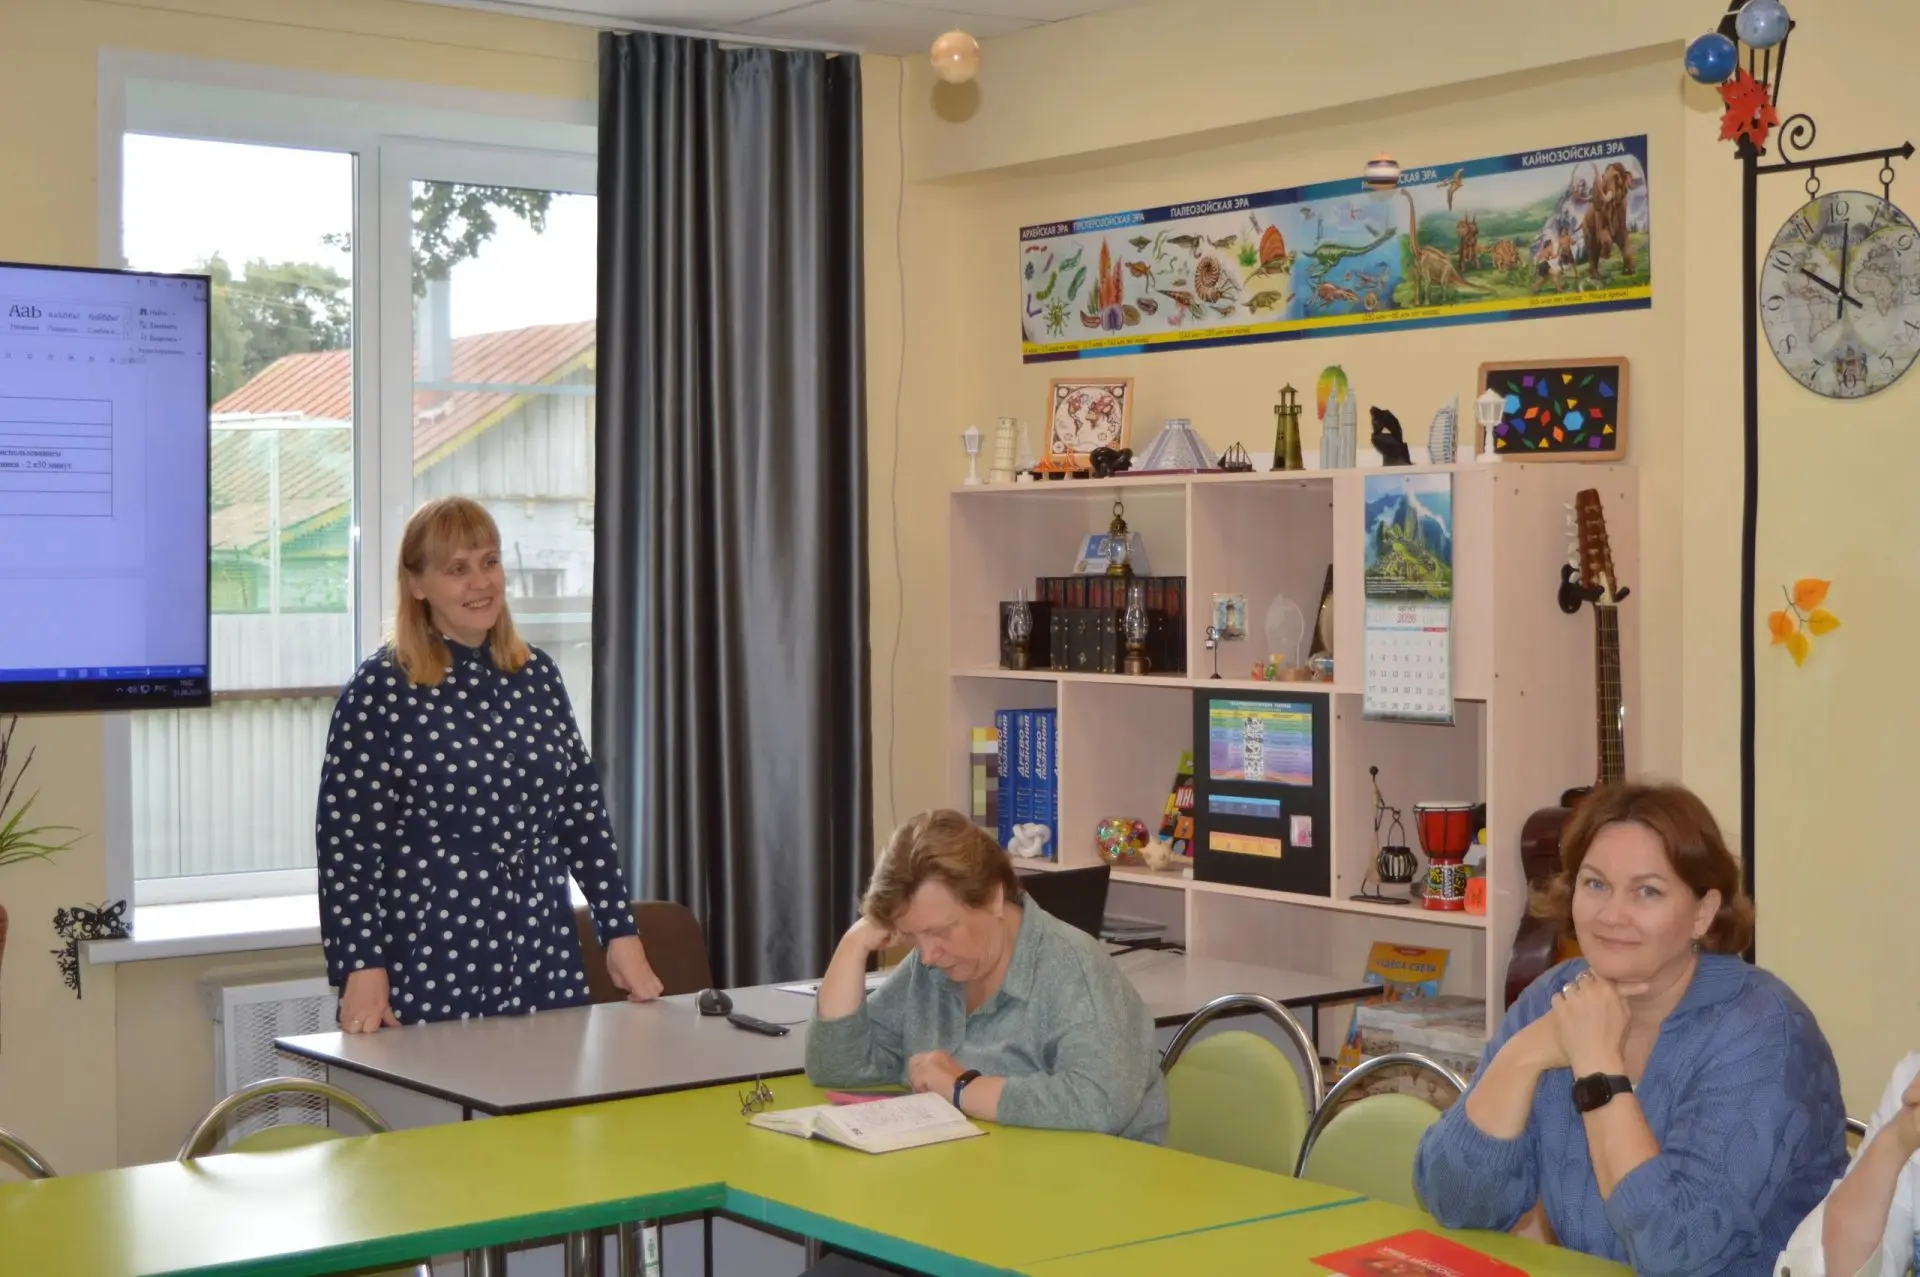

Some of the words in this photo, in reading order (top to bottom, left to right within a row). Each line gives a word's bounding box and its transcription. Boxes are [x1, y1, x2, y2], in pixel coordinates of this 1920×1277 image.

[1522, 145, 1603, 167] КАЙНОЗОЙСКАЯ
[1606, 142, 1625, 155] ЭРА
[1421, 169, 1438, 182] ЭРА
[1131, 212, 1146, 224] ЭРА
[1170, 200, 1233, 218] ПАЛЕОЗОЙСКАЯ
[1234, 197, 1250, 209] ЭРА
[1829, 200, 1850, 224] 12
[1022, 226, 1056, 240] АРХЕЙСКАЯ
[1056, 224, 1069, 235] ЭРА
[1795, 216, 1815, 240] 11
[1772, 249, 1795, 274] 10
[1767, 295, 1786, 312] 9
[1779, 333, 1798, 355] 8
[1810, 358, 1825, 381] 7
[1842, 367, 1857, 390] 6
[1017, 729, 1025, 778] ДРЕВО
